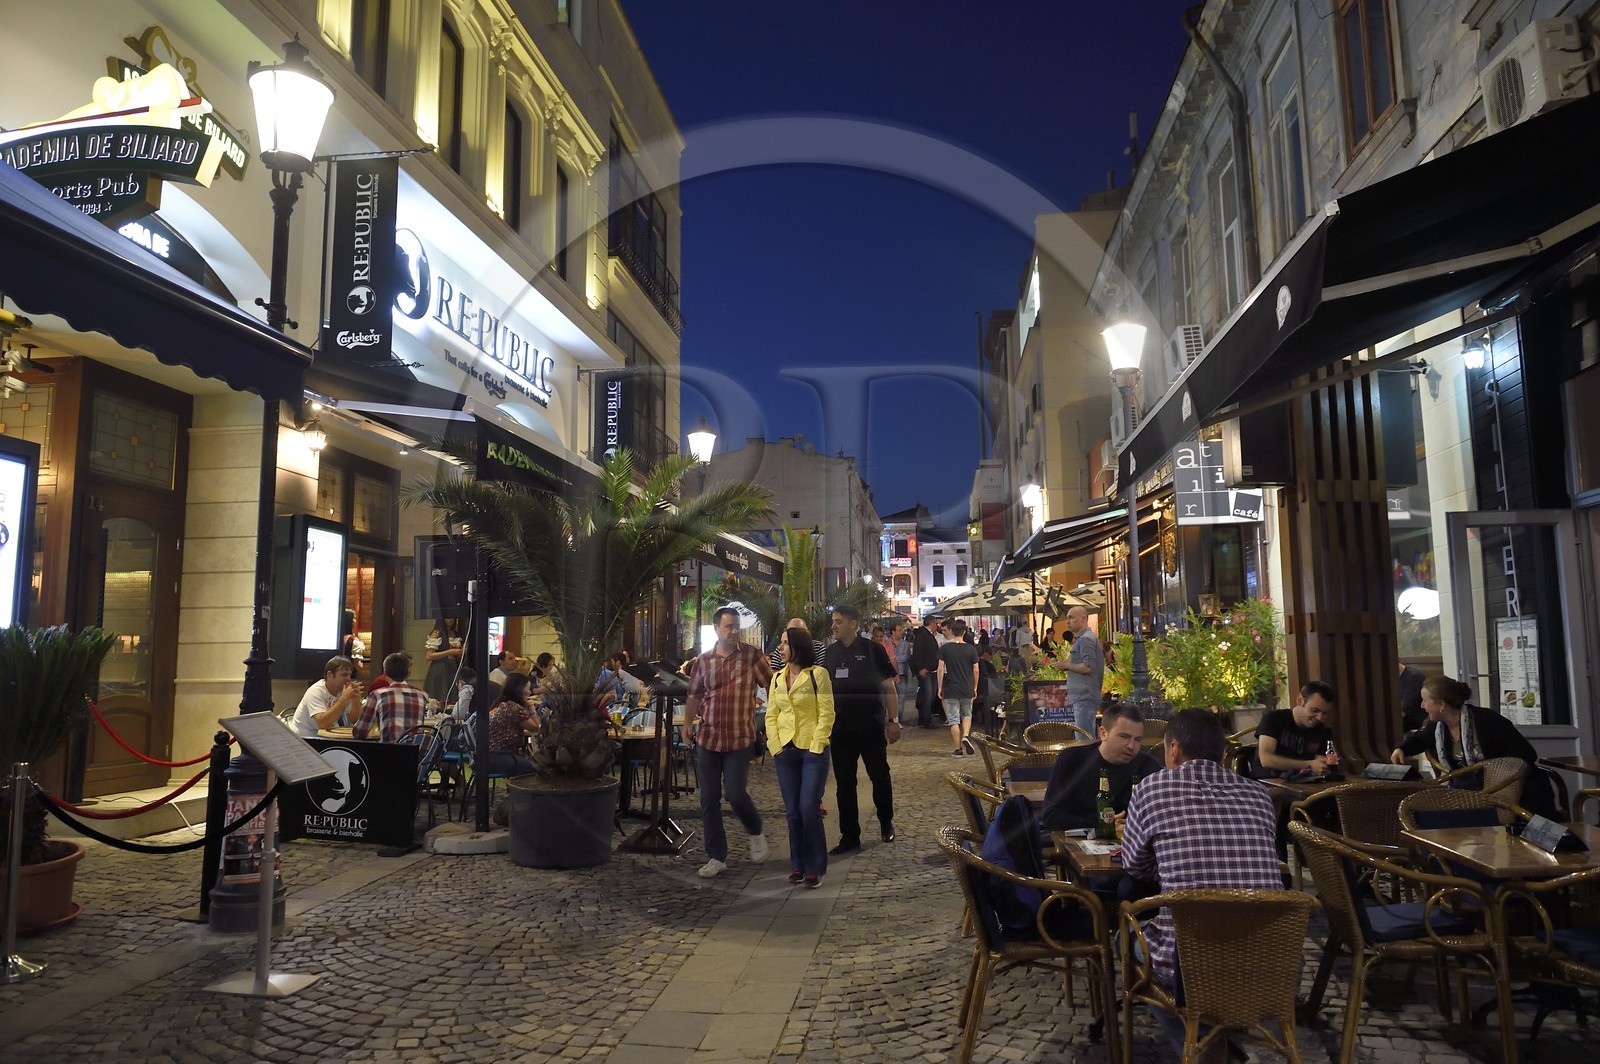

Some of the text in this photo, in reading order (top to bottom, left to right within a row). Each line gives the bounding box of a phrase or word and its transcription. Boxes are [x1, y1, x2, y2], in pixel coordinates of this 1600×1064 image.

[0, 131, 199, 170] ADEMIA DE BILIARD
[46, 172, 139, 201] orts Pub
[353, 174, 373, 282] RE:PUBLIC
[336, 329, 380, 350] Carlsberg
[433, 276, 554, 394] RE:PUBLIC
[444, 349, 457, 366] That
[458, 358, 470, 374] calls
[470, 367, 478, 378] for
[484, 372, 507, 400] Carlsberg
[607, 381, 618, 446] RE:PUBLIC
[1234, 508, 1258, 519] café
[1484, 378, 1520, 618] SILER
[304, 814, 368, 830] RE:PUBLIC
[306, 826, 332, 836] brasserie
[339, 828, 364, 838] bierhalle
